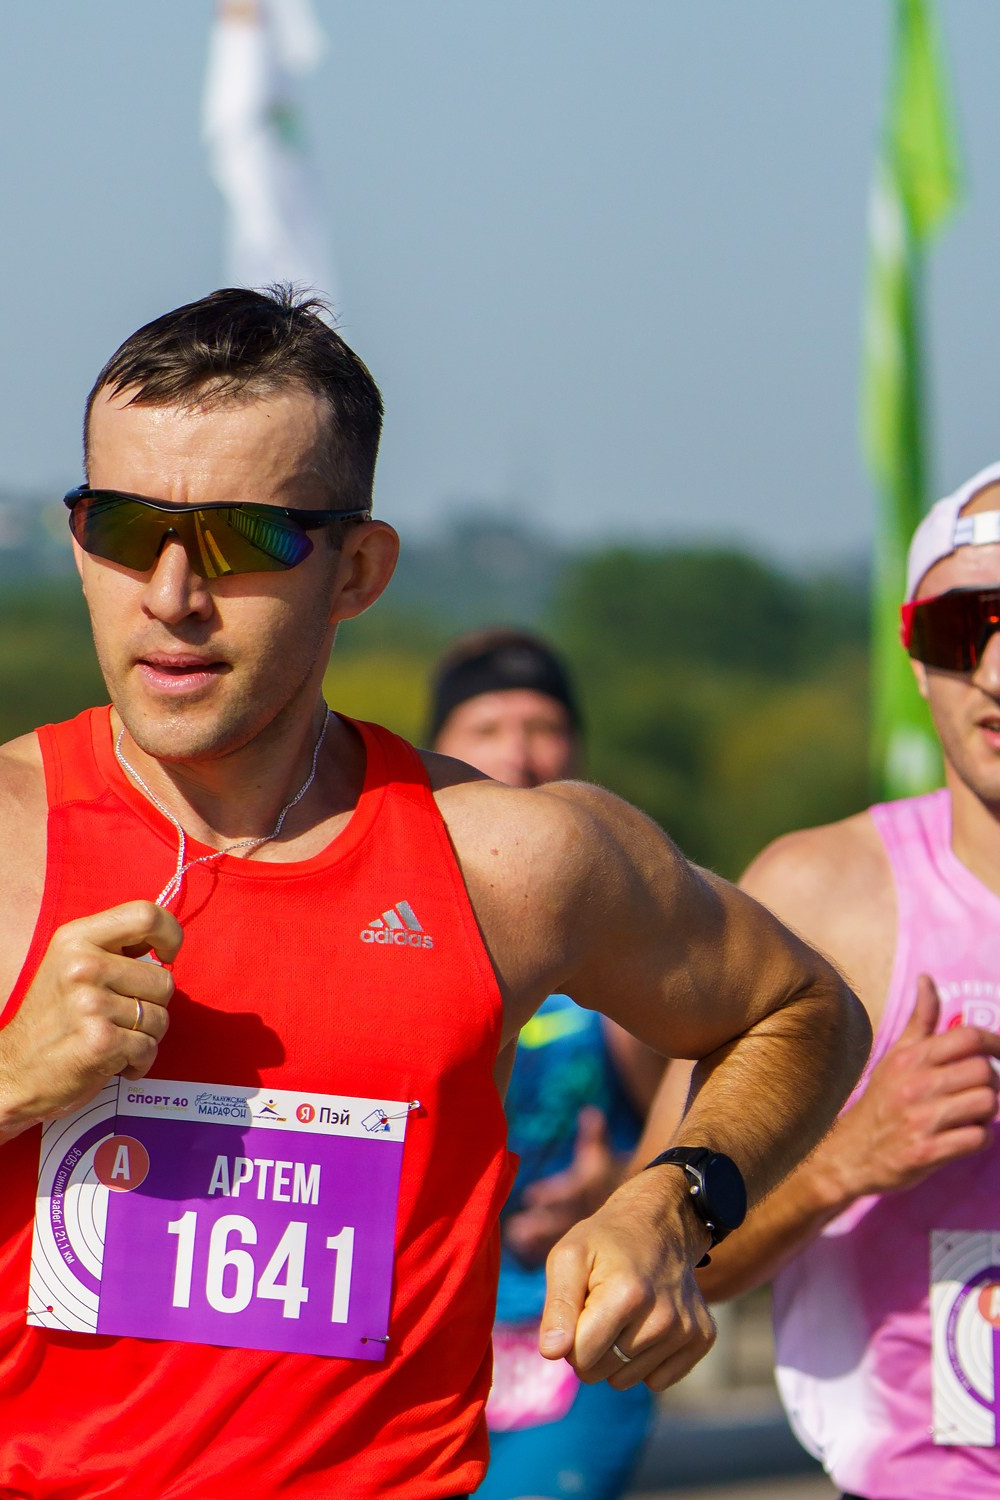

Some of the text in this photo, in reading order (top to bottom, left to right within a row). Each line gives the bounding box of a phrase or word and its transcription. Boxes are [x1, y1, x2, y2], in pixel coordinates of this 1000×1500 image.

[360, 927, 434, 949] adidas
[127, 1094, 189, 1107] СПОРТ 40
[198, 1105, 247, 1118] МАРАФОН
[301, 1106, 350, 1125] Я Пэй
[65, 1147, 82, 1167] 9:05
[208, 1155, 321, 1205] АРТЕМ
[52, 1199, 63, 1224] забег
[167, 1210, 355, 1324] 1641
